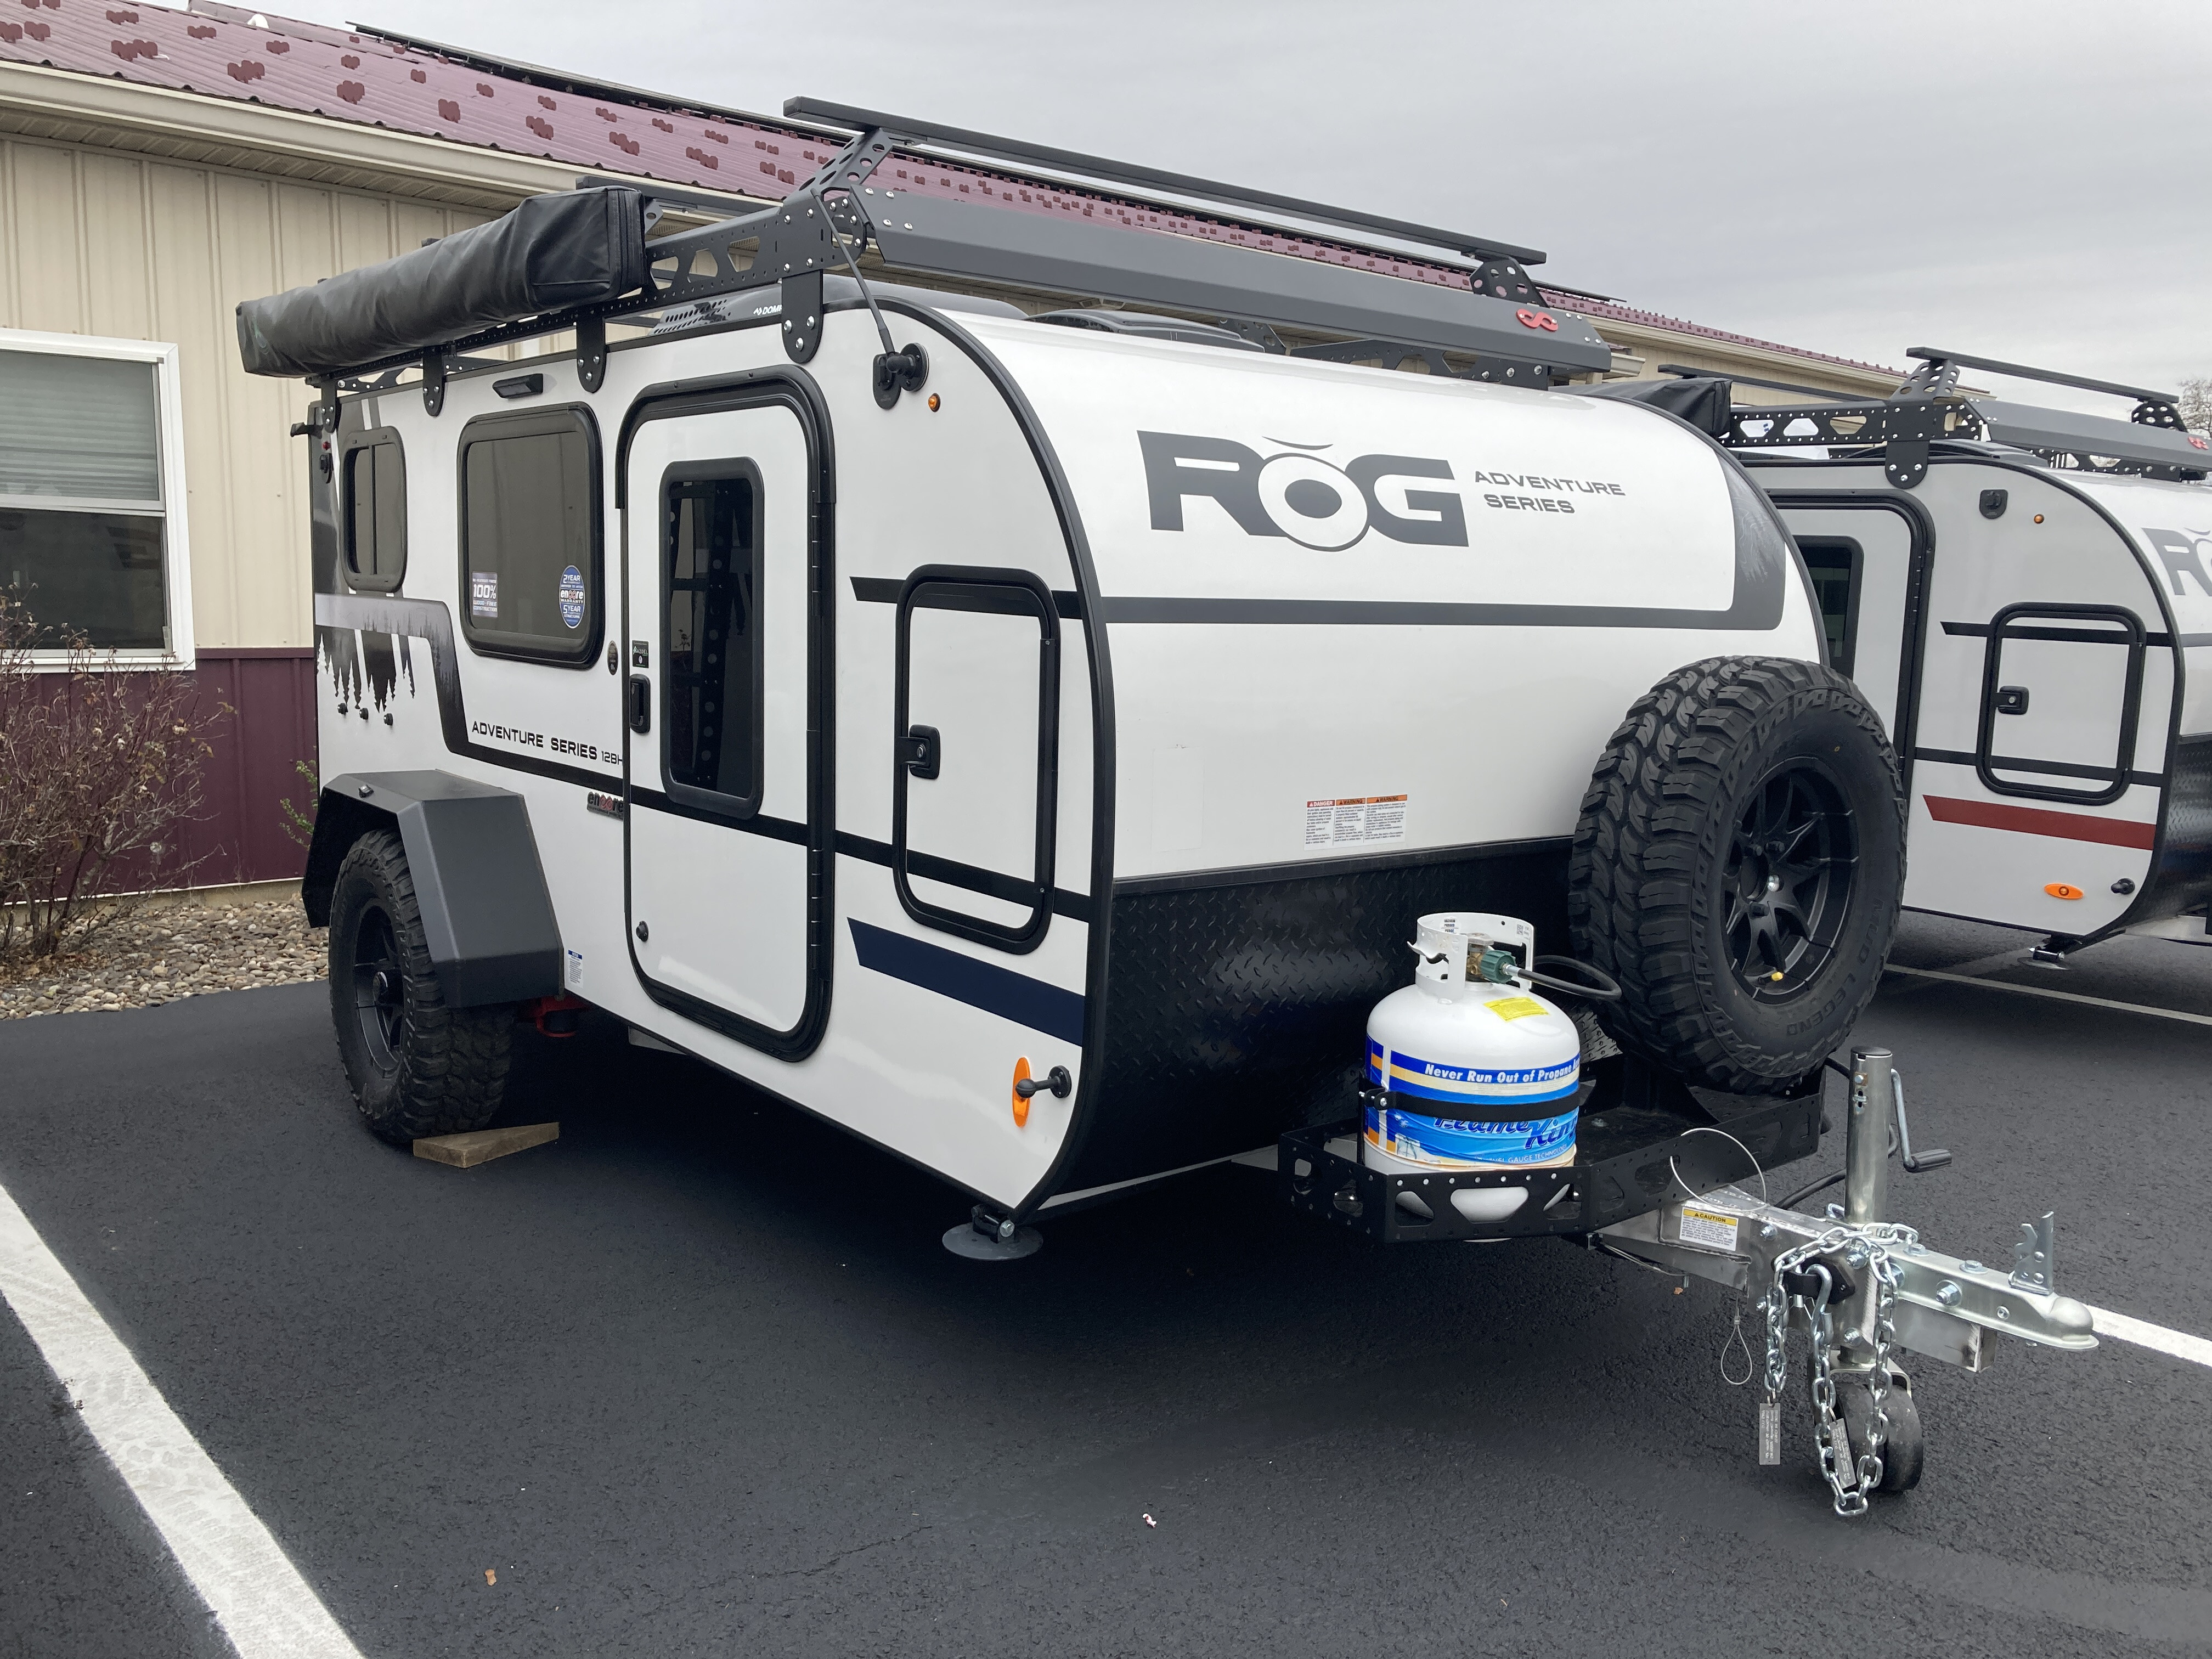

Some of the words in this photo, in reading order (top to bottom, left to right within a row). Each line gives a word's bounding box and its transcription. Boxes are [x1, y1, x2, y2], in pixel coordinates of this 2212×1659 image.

[1137, 430, 1469, 552] ROG
[1475, 470, 1626, 496] ADVENTURE
[1483, 493, 1575, 514] SERIES
[473, 584, 496, 599] 100%
[472, 721, 544, 748] ADVENTURE
[551, 737, 597, 760] SERIES
[1786, 972, 1857, 1036] LEGEND
[1425, 1064, 1463, 1081] Never
[1467, 1070, 1493, 1083] Run
[1497, 1071, 1519, 1084] Out
[1522, 1070, 1536, 1083] of
[1537, 1064, 1572, 1082] Propane
[1508, 1154, 1533, 1163] GAUGE
[1700, 1214, 1726, 1223] CAUTION
